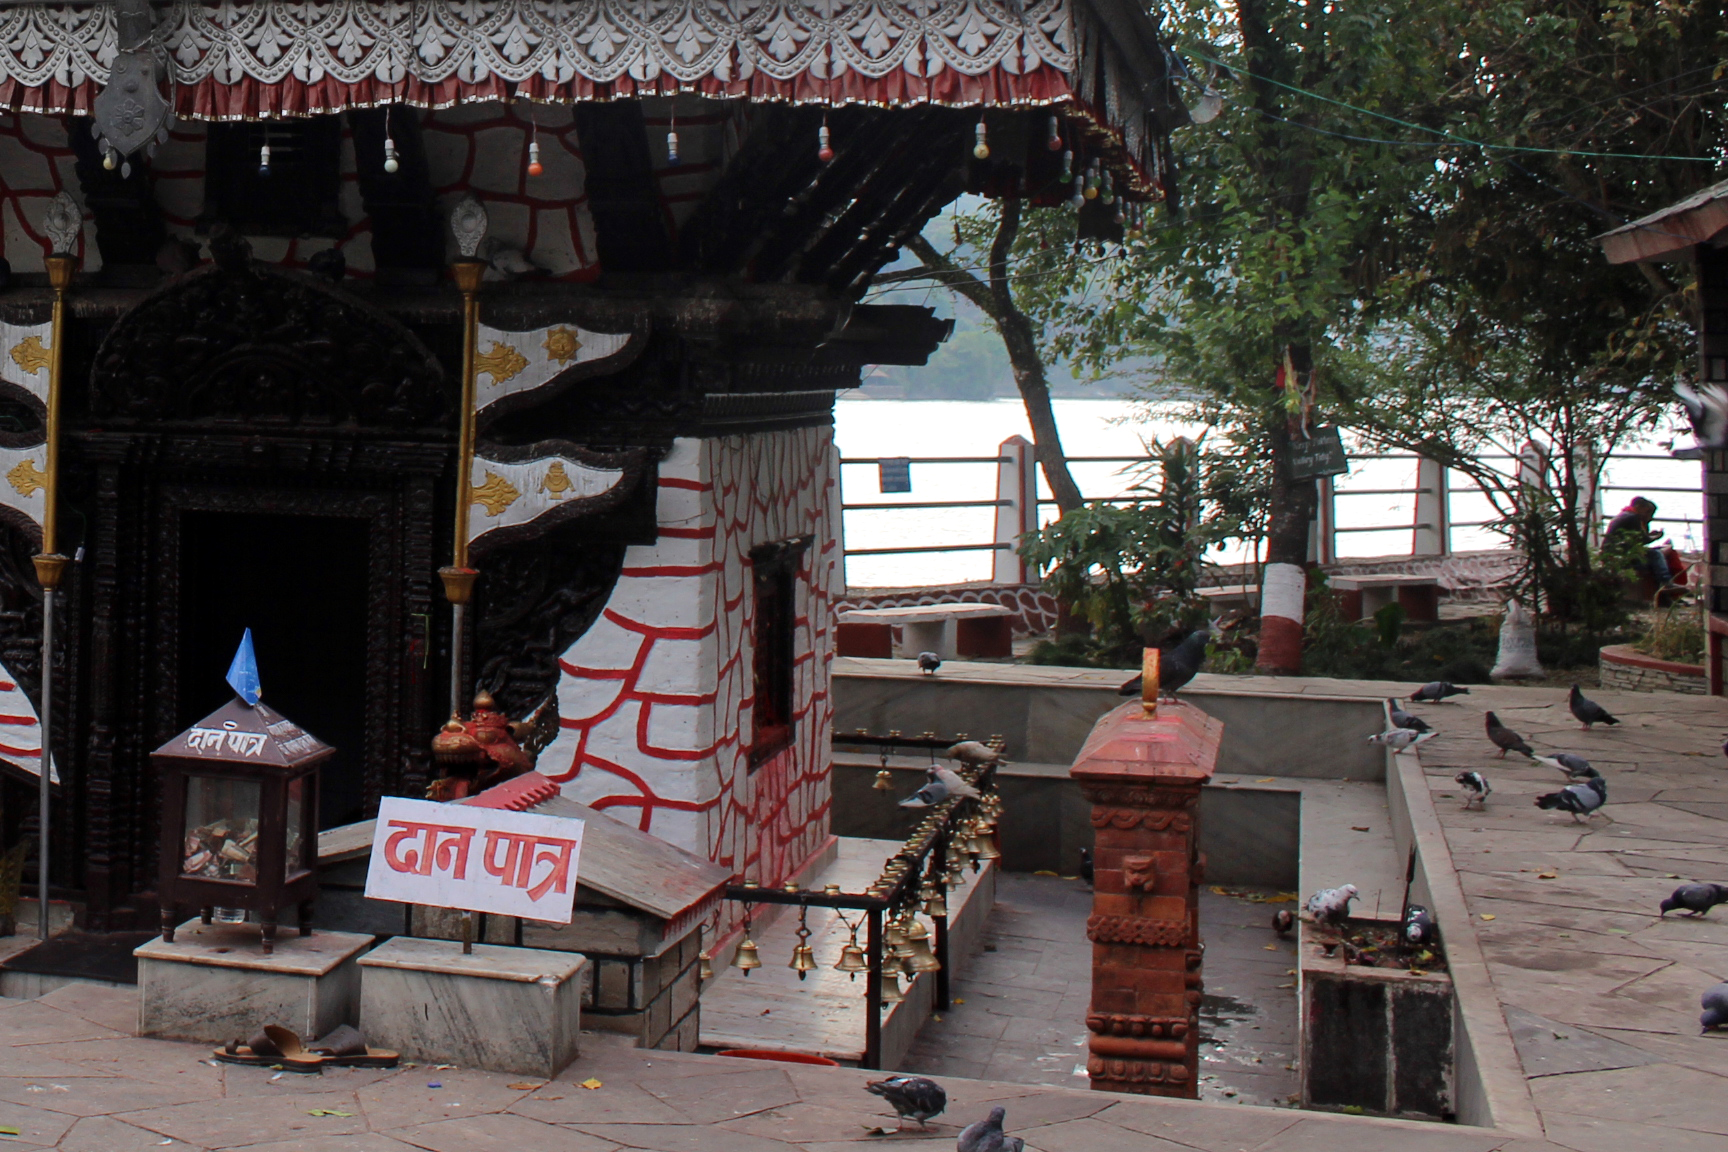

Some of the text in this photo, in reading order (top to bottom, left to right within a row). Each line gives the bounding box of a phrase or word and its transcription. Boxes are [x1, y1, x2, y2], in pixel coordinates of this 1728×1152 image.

[188, 727, 228, 753] दान
[227, 730, 268, 757] पात्र
[384, 819, 577, 903] दान पात्र
